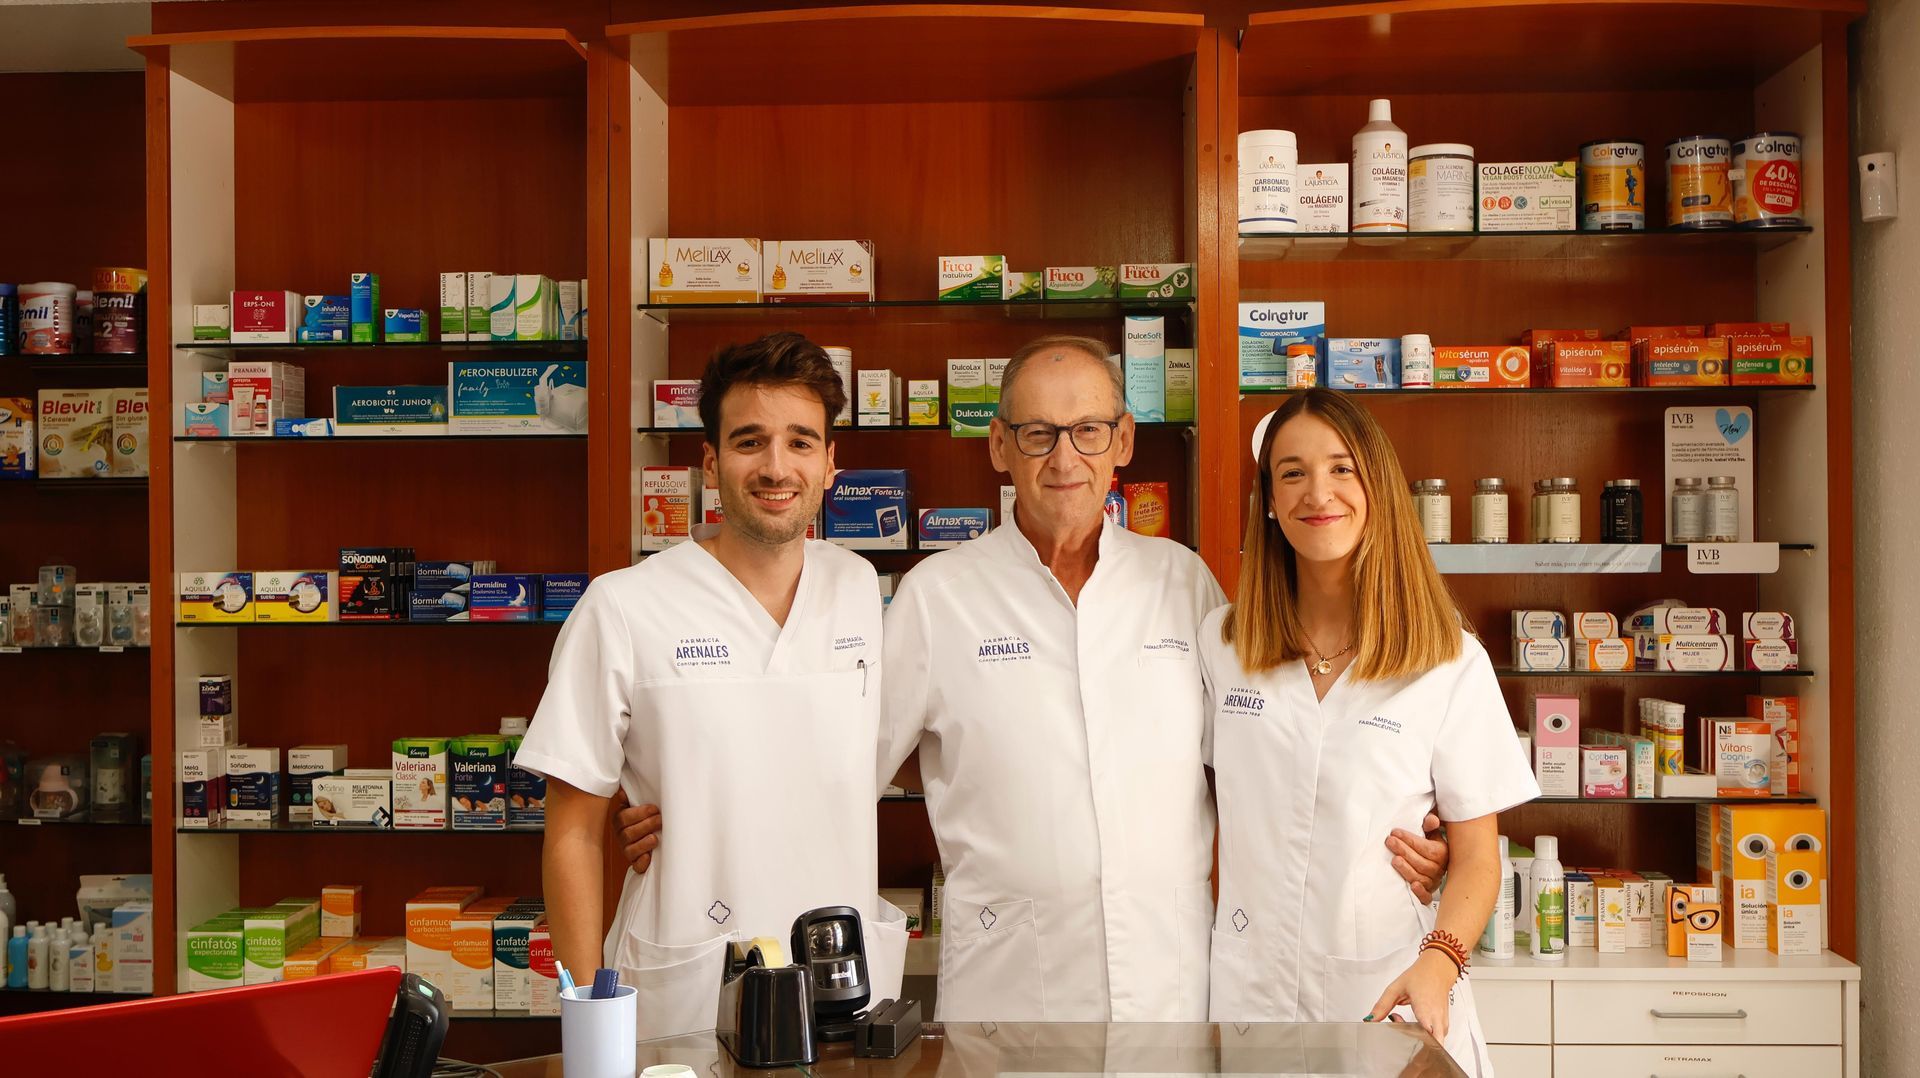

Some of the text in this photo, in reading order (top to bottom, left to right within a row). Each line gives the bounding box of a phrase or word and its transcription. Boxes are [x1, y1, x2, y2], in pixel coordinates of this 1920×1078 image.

[1592, 145, 1638, 158] Colnatur
[1482, 165, 1555, 176] COLAGENOVA
[1765, 164, 1796, 184] 40%
[1300, 194, 1344, 205] COLÁGENO
[942, 260, 973, 272] Fuca
[1049, 268, 1084, 282] Fuca
[1125, 265, 1160, 279] Fuca
[1249, 309, 1309, 324] Colnatur
[1559, 347, 1603, 358] apisérum
[1653, 344, 1699, 355] apisérum
[1736, 342, 1782, 355] apisérum
[42, 400, 95, 414] Blevit
[351, 398, 432, 407] AEROBIOTIC JUNIOR
[956, 409, 994, 417] DulcoLax
[1671, 413, 1694, 424] IVB
[834, 485, 873, 496] Almax
[874, 488, 892, 496] Forte
[926, 515, 961, 526] Almax
[341, 552, 387, 564] SOÑODINA
[1697, 549, 1720, 560] IVB
[417, 568, 450, 576] dormirel
[546, 580, 581, 588] Dormidina
[983, 636, 1021, 644] FARMACIA
[1675, 640, 1718, 648] Multicentrum
[675, 645, 729, 660] ARENALES
[978, 642, 1030, 657] ARENALES
[1230, 687, 1261, 695] FARMACIA
[1223, 694, 1265, 711] ARENALES
[1358, 719, 1401, 734] FARMACÉUTICA
[1372, 715, 1402, 728] AMPARO
[1720, 743, 1753, 753] Vitans
[1542, 749, 1552, 759] ia
[395, 761, 437, 771] Valeriana
[454, 761, 496, 773] Valeriana
[395, 772, 417, 781] Classic
[454, 773, 473, 782] Forte
[1740, 884, 1755, 899] ia
[1783, 907, 1793, 918] ia
[409, 918, 452, 927] cinfamuco
[191, 937, 238, 950] cinfatós
[245, 936, 282, 946] cinfatós
[453, 939, 489, 947] cinfamucol
[530, 948, 554, 957] cinfat
